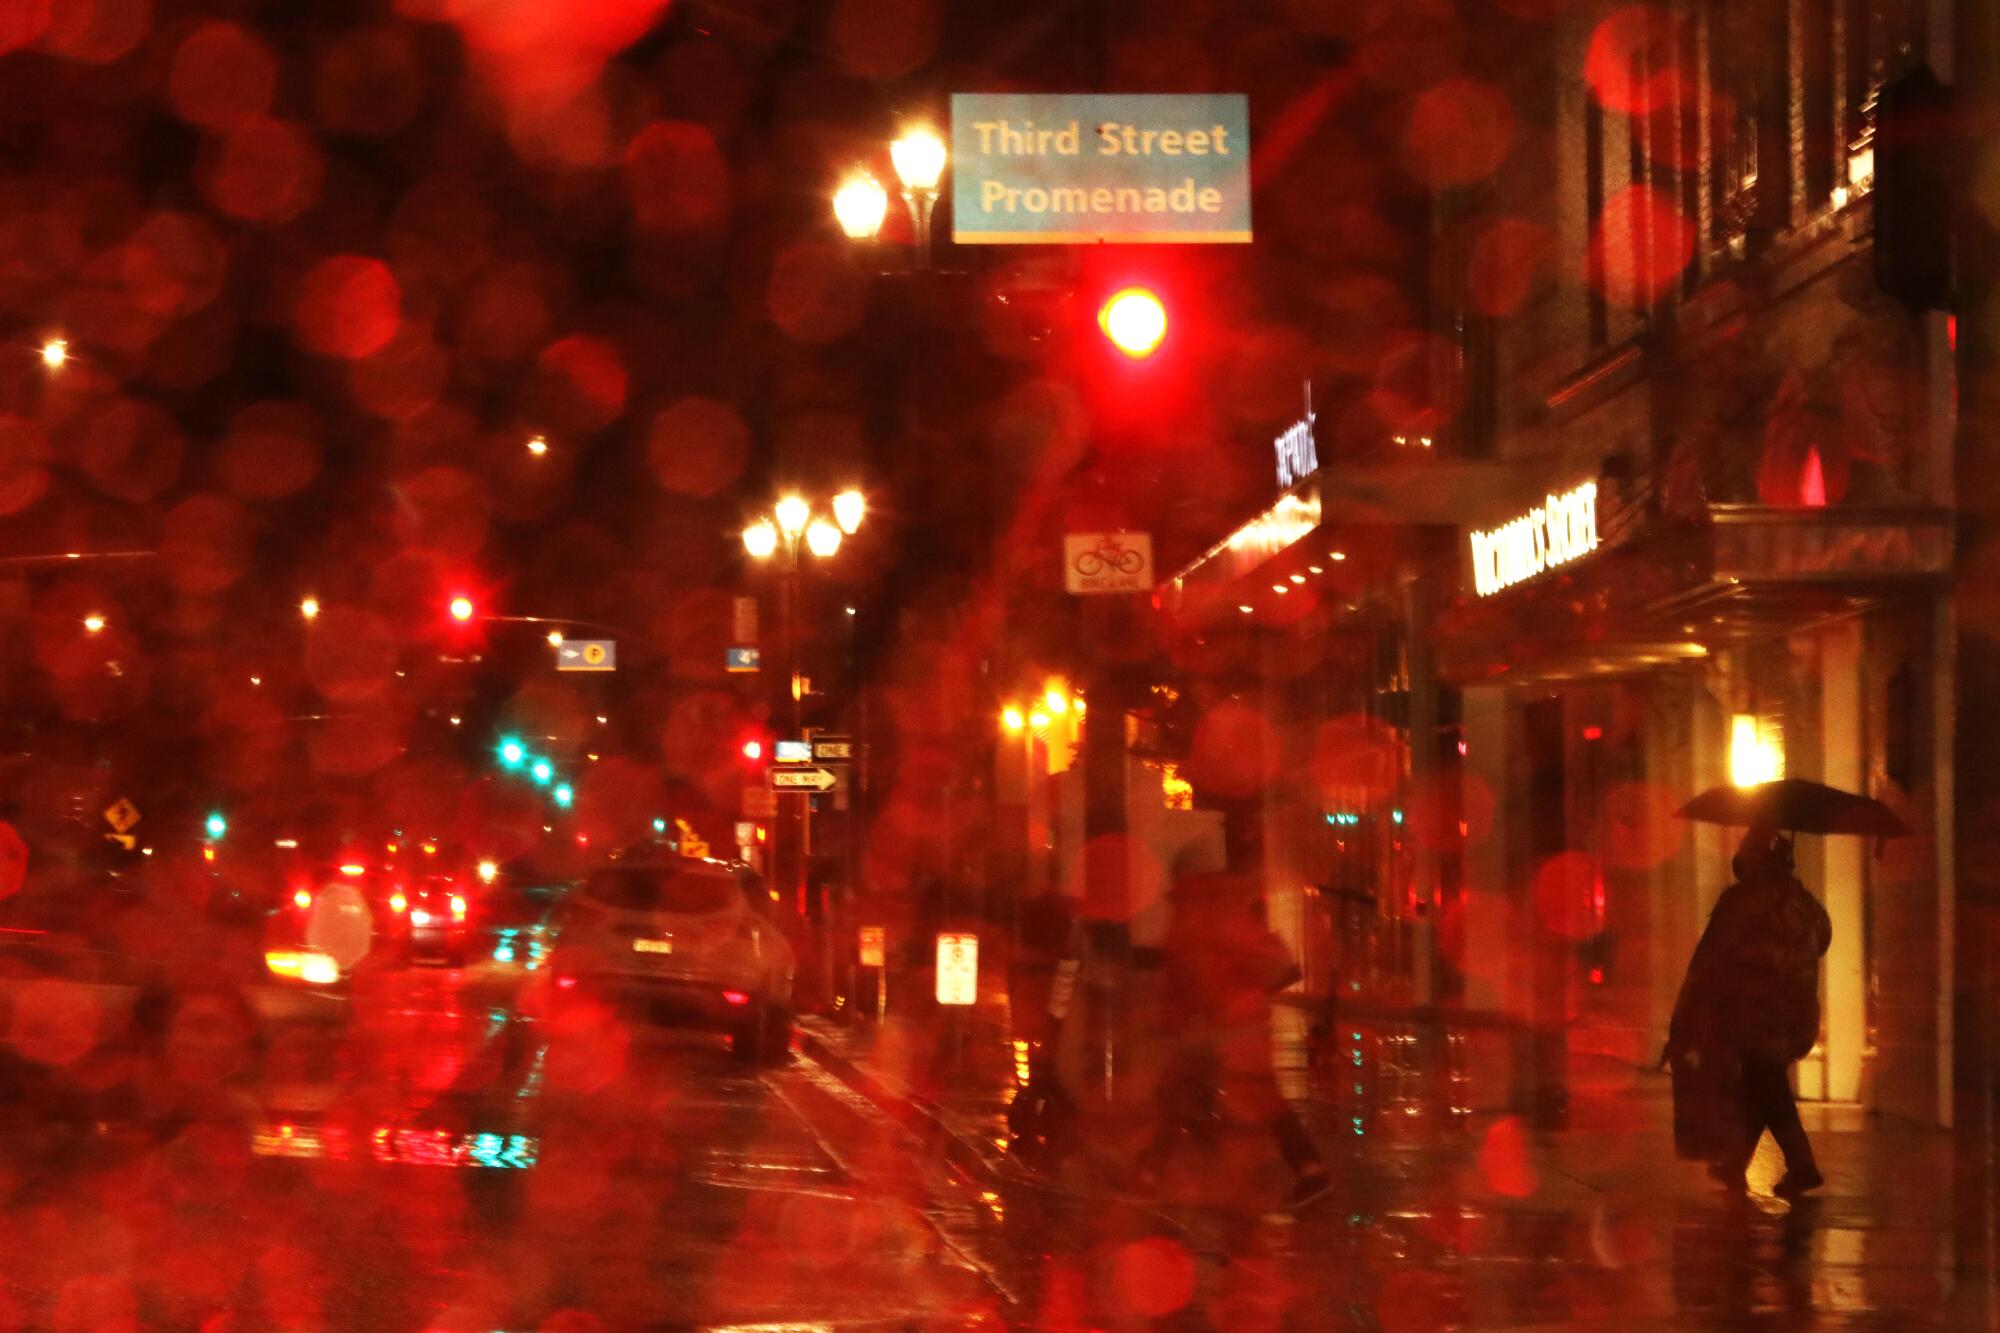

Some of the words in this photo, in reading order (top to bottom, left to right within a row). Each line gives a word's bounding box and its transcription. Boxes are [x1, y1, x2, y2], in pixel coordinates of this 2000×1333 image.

[974, 120, 1080, 155] Third
[1099, 121, 1230, 156] Street
[981, 177, 1223, 214] Promenade
[779, 775, 798, 785] ONE
[802, 775, 823, 784] WAY
